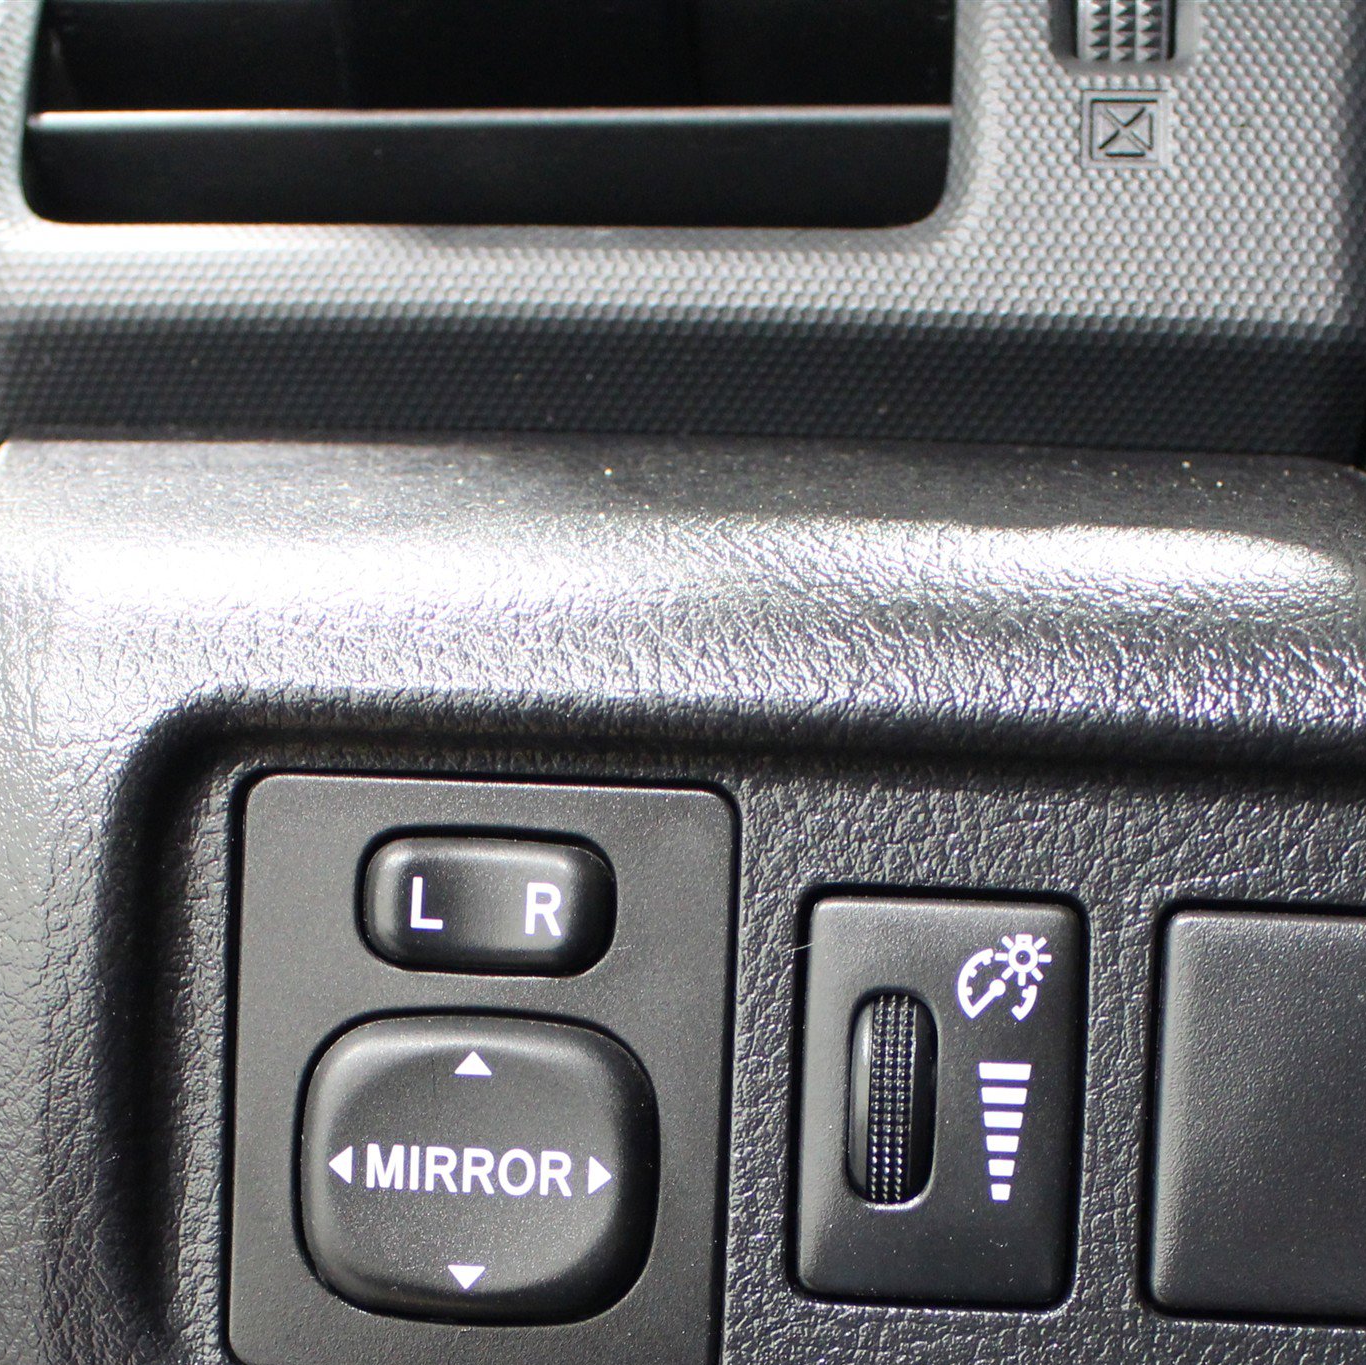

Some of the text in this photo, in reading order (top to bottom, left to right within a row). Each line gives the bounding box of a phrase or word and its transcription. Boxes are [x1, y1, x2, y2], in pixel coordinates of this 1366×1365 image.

[409, 876, 563, 937] L R
[365, 1143, 573, 1198] MIRROR
